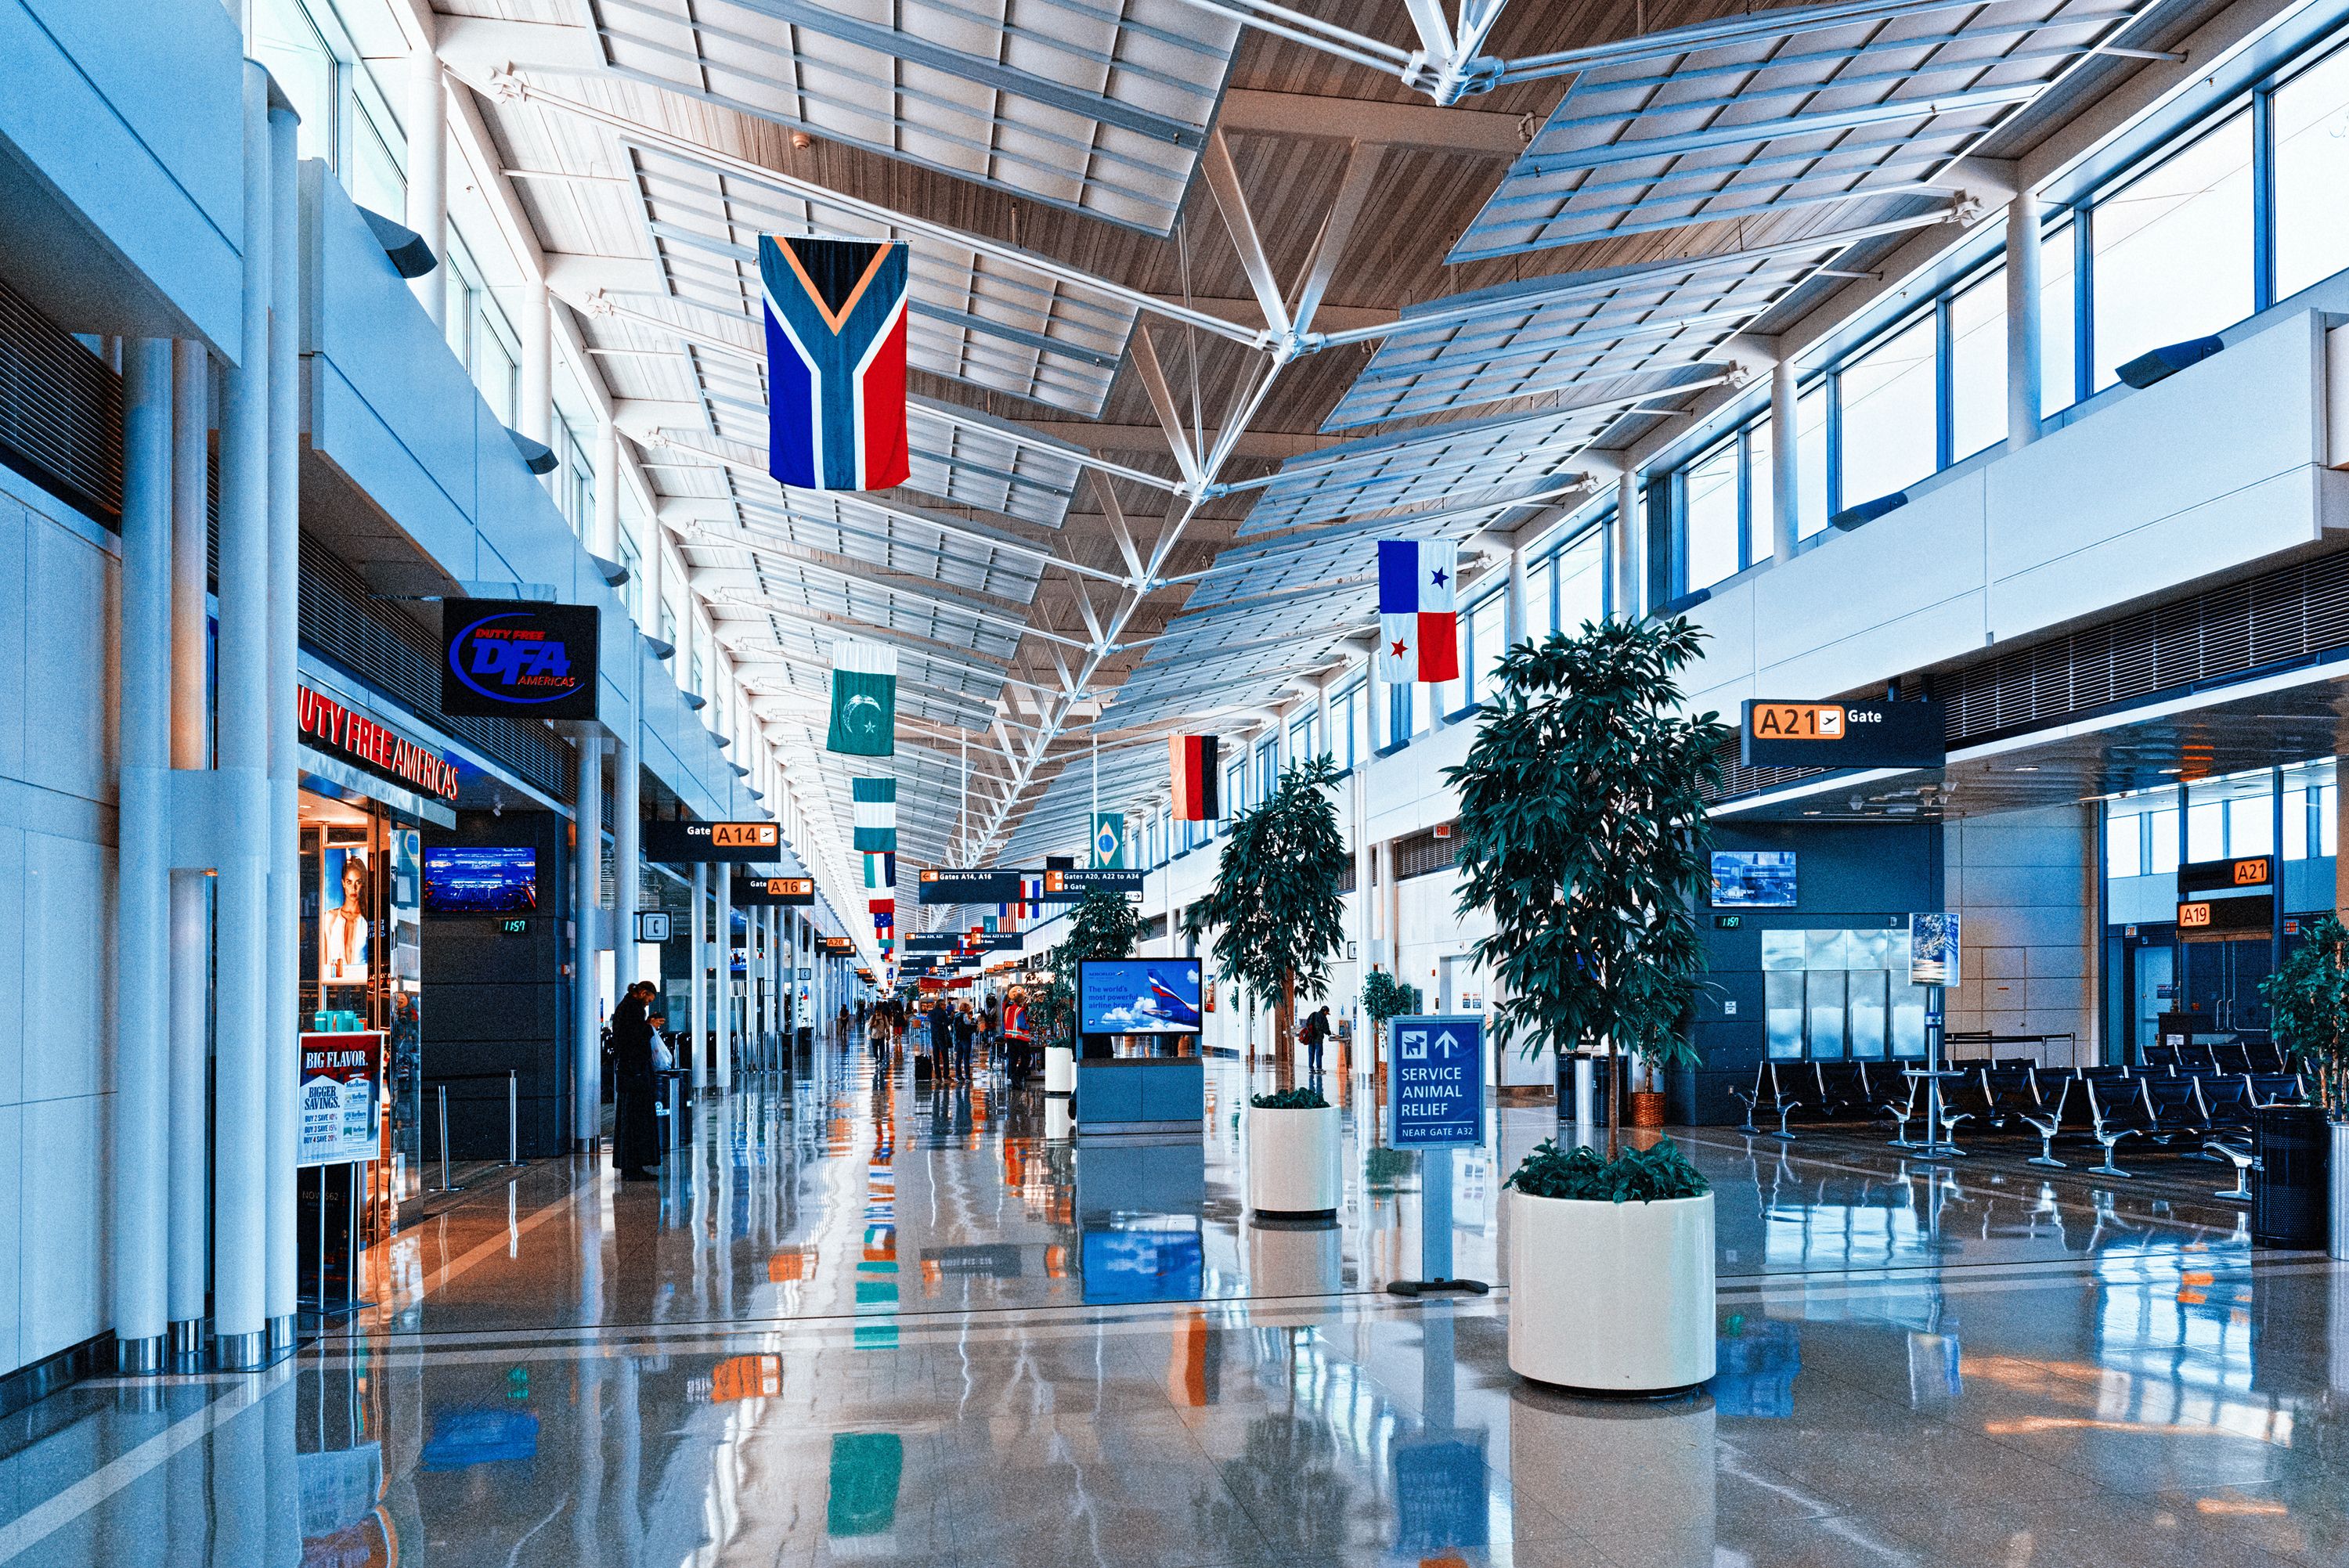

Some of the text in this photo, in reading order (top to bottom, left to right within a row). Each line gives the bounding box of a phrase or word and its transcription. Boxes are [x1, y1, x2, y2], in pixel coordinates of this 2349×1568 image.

[475, 629, 546, 640] DUTY FREE
[471, 639, 572, 685] DFA
[518, 676, 576, 687] AMERICAS
[1759, 708, 1882, 735] A21 Gate
[298, 683, 460, 800] UTY FREE AMERICAS
[687, 827, 757, 843] Gate A14
[1437, 826, 1449, 836] EXIT
[2237, 863, 2264, 881] A21
[770, 881, 798, 892] A16
[1723, 917, 1739, 927] 11:57
[2183, 907, 2207, 924] A19
[505, 921, 525, 932] 11:57
[1107, 993, 1138, 1002] powerful
[306, 1051, 368, 1069] BIG FLAVOR.
[1402, 1068, 1462, 1080] SERVICE
[309, 1086, 336, 1098] BIGGER
[1402, 1085, 1463, 1098] ANIMAL
[305, 1097, 340, 1110] SAVINGS.
[1402, 1103, 1448, 1116] RELIEF
